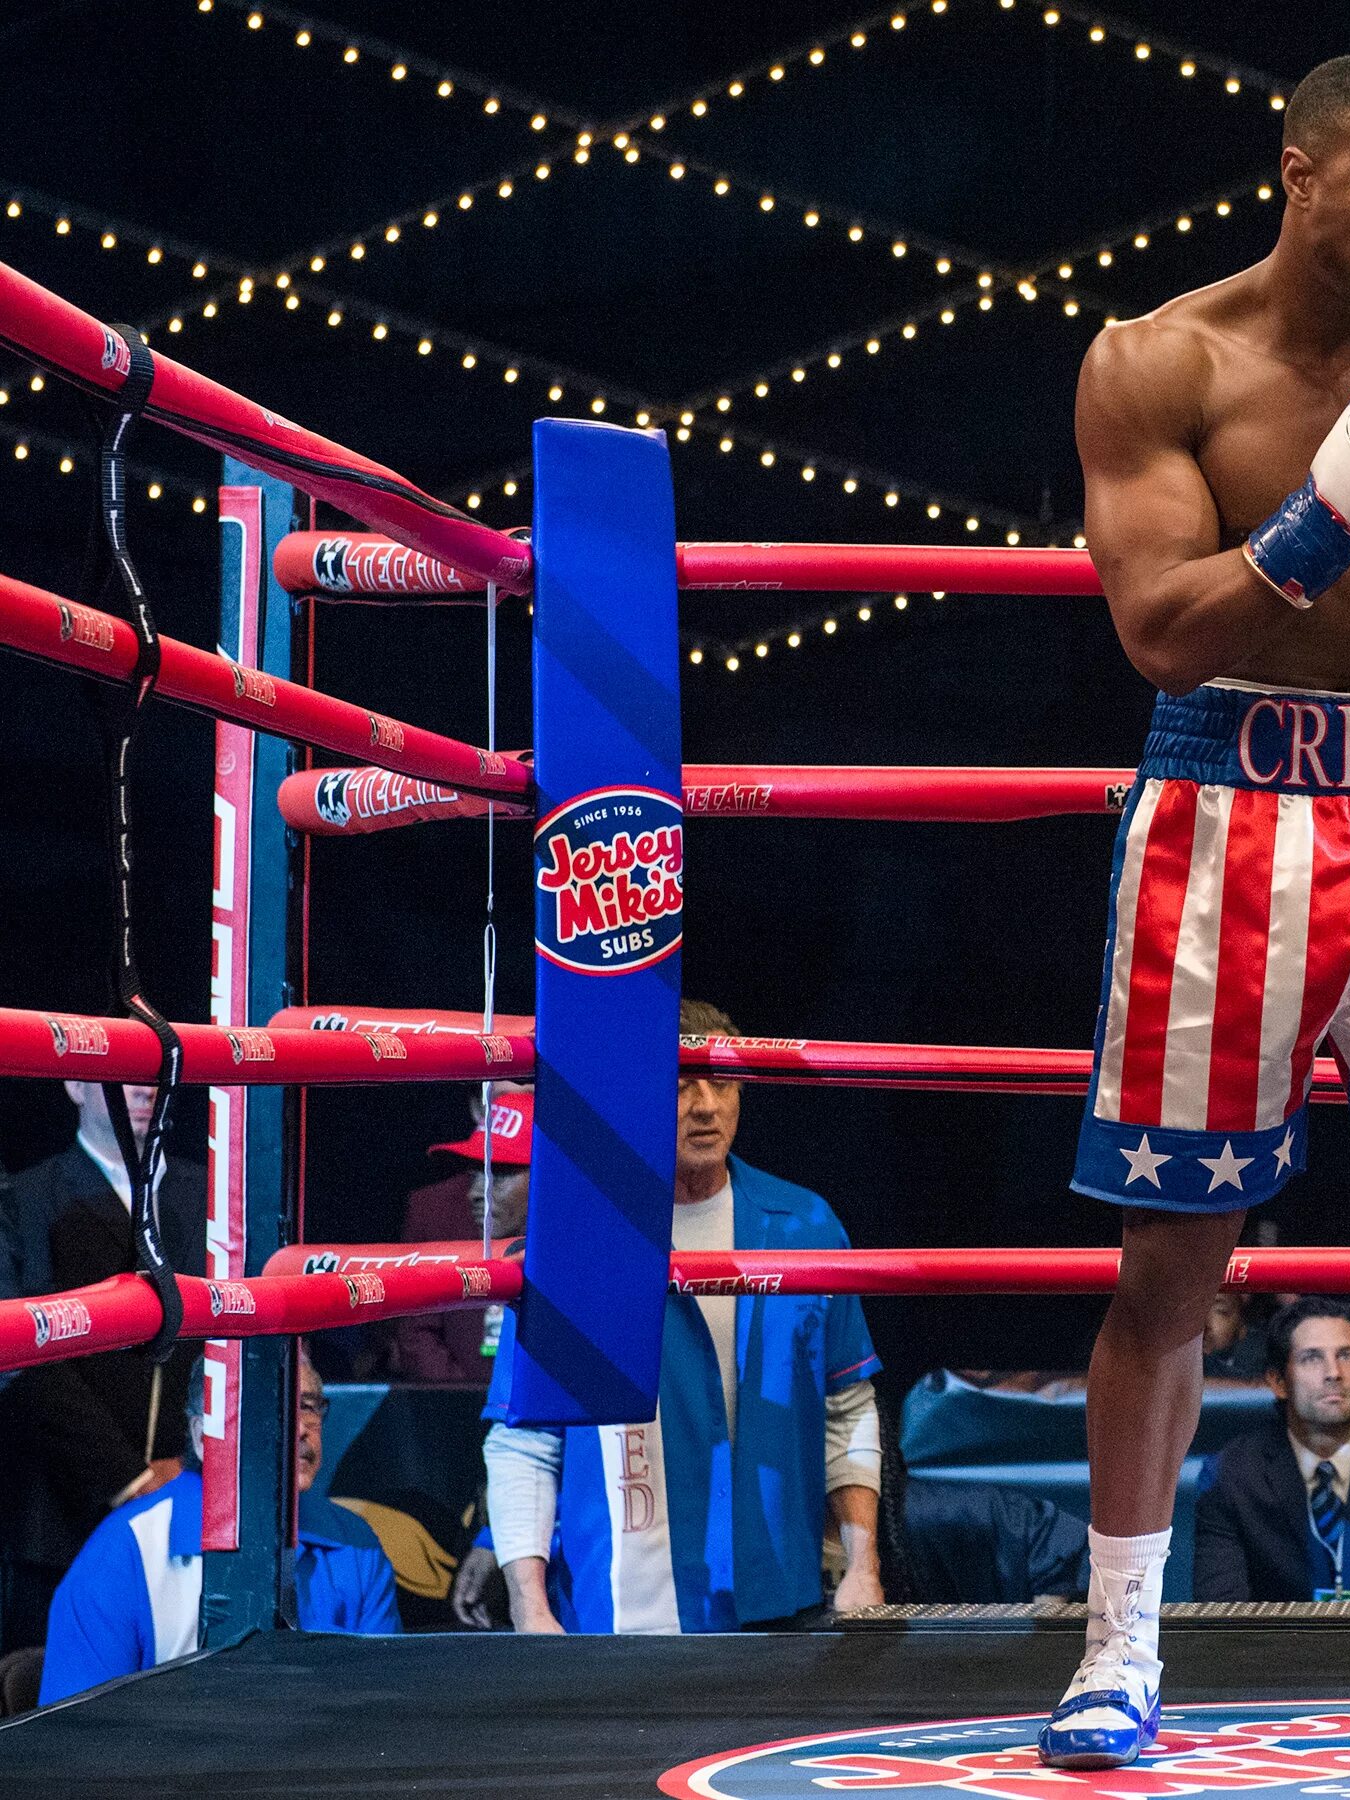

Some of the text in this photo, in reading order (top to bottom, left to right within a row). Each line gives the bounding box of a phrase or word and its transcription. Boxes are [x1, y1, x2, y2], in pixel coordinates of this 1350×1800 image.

[573, 806, 642, 829] SINCE 1956
[538, 825, 683, 889] Jersey
[557, 870, 683, 943] Mike's
[600, 928, 654, 959] SUBS
[683, 1273, 783, 1295] TECATE
[879, 1727, 1028, 1748] SINCE
